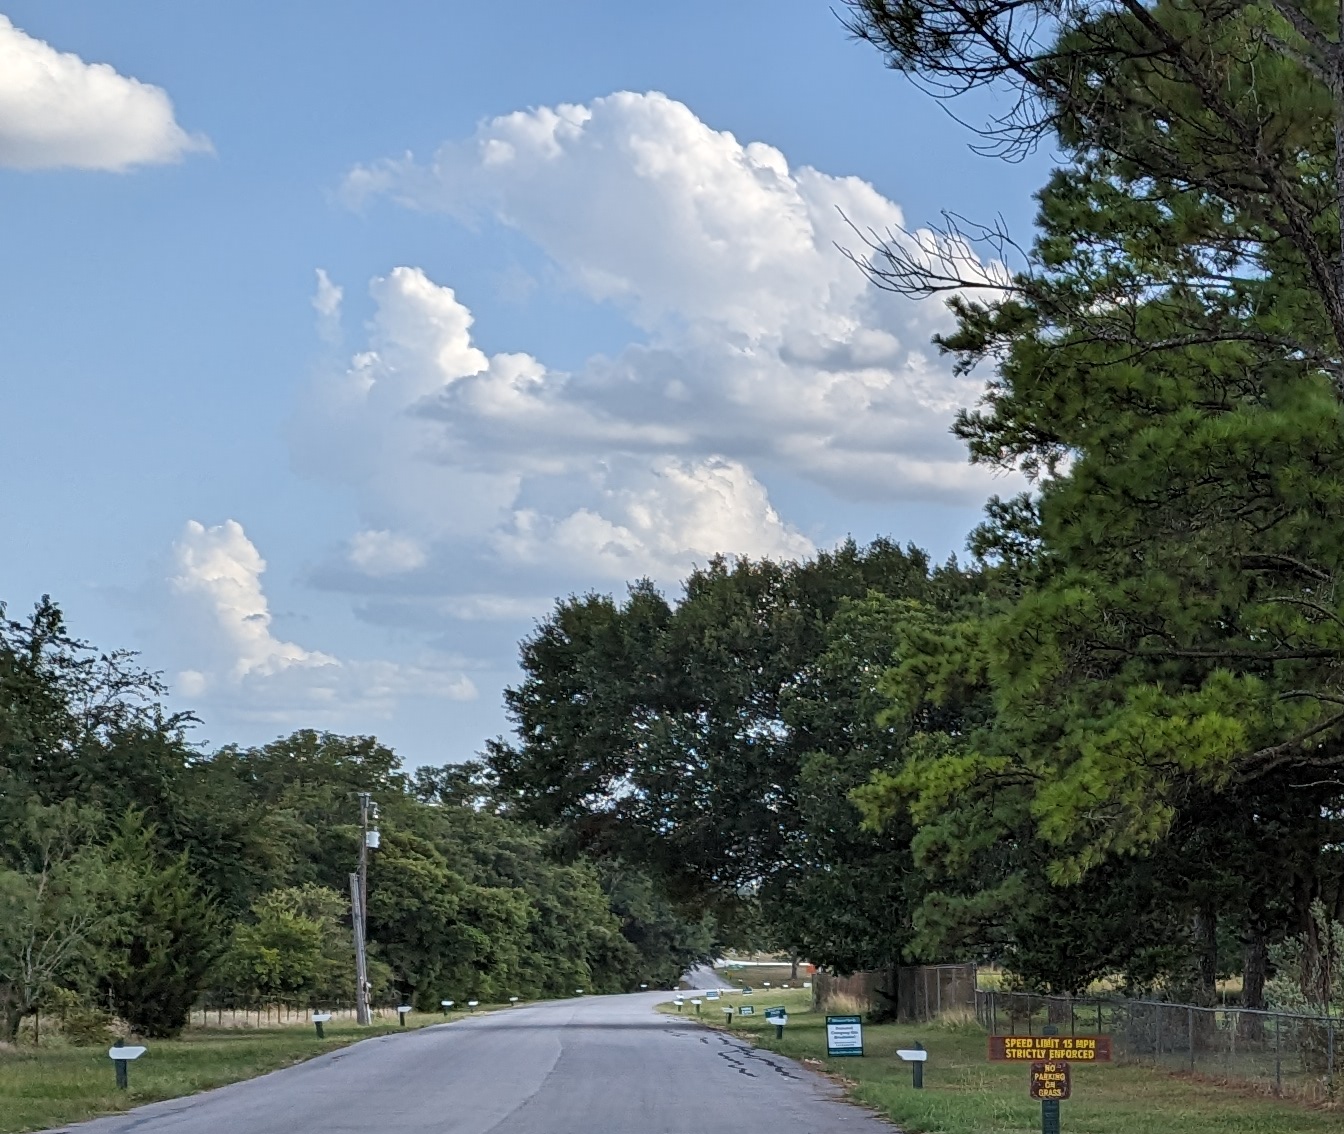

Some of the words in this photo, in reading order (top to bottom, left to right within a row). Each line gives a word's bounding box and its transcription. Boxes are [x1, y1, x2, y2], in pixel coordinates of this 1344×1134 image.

[1005, 1038, 1033, 1048] SPEED
[1036, 1038, 1060, 1048] LIMIT
[1063, 1039, 1073, 1048] 15
[1076, 1039, 1095, 1048] MPH
[1006, 1049, 1046, 1059] STRICTLY
[1049, 1049, 1094, 1059] ENFORCED
[1044, 1064, 1056, 1072] NO
[1034, 1073, 1065, 1081] PARKING
